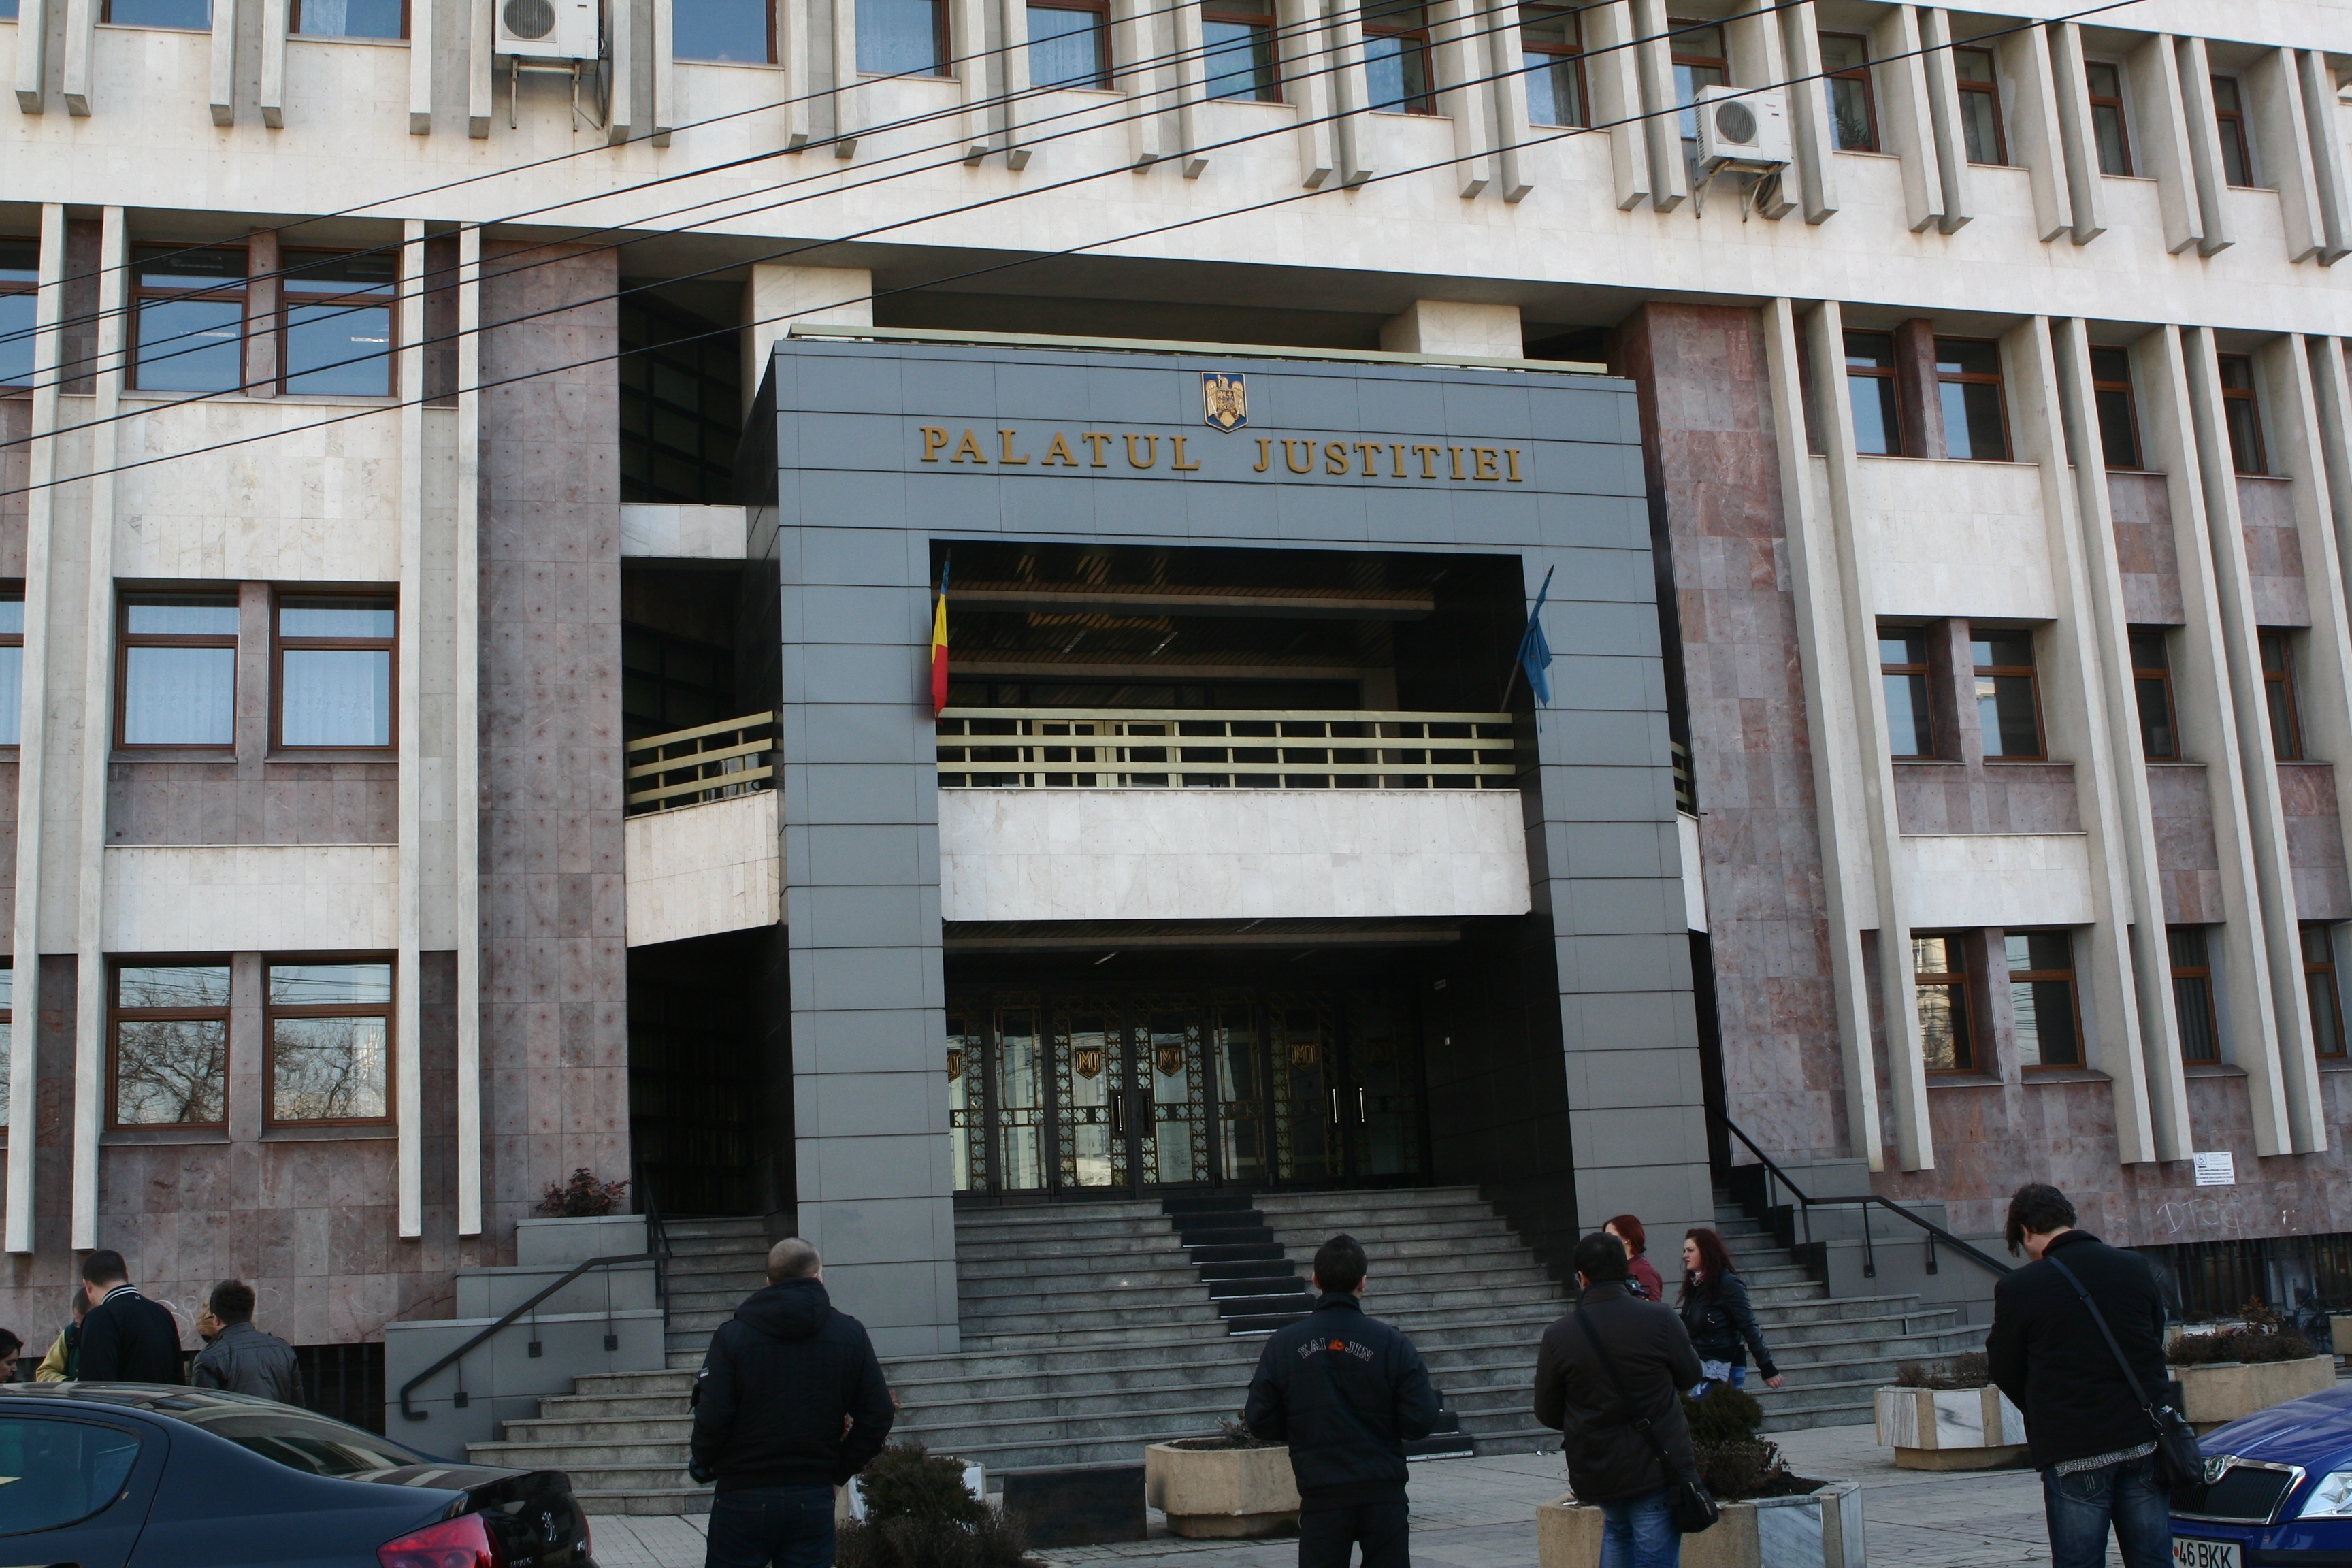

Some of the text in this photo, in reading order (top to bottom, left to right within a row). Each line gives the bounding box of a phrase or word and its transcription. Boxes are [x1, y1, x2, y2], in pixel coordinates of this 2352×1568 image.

[920, 426, 1523, 483] PALATUL JUSTITIEI
[1298, 1337, 1373, 1361] KAI JIN
[2179, 1541, 2232, 1568] 46 BKK
